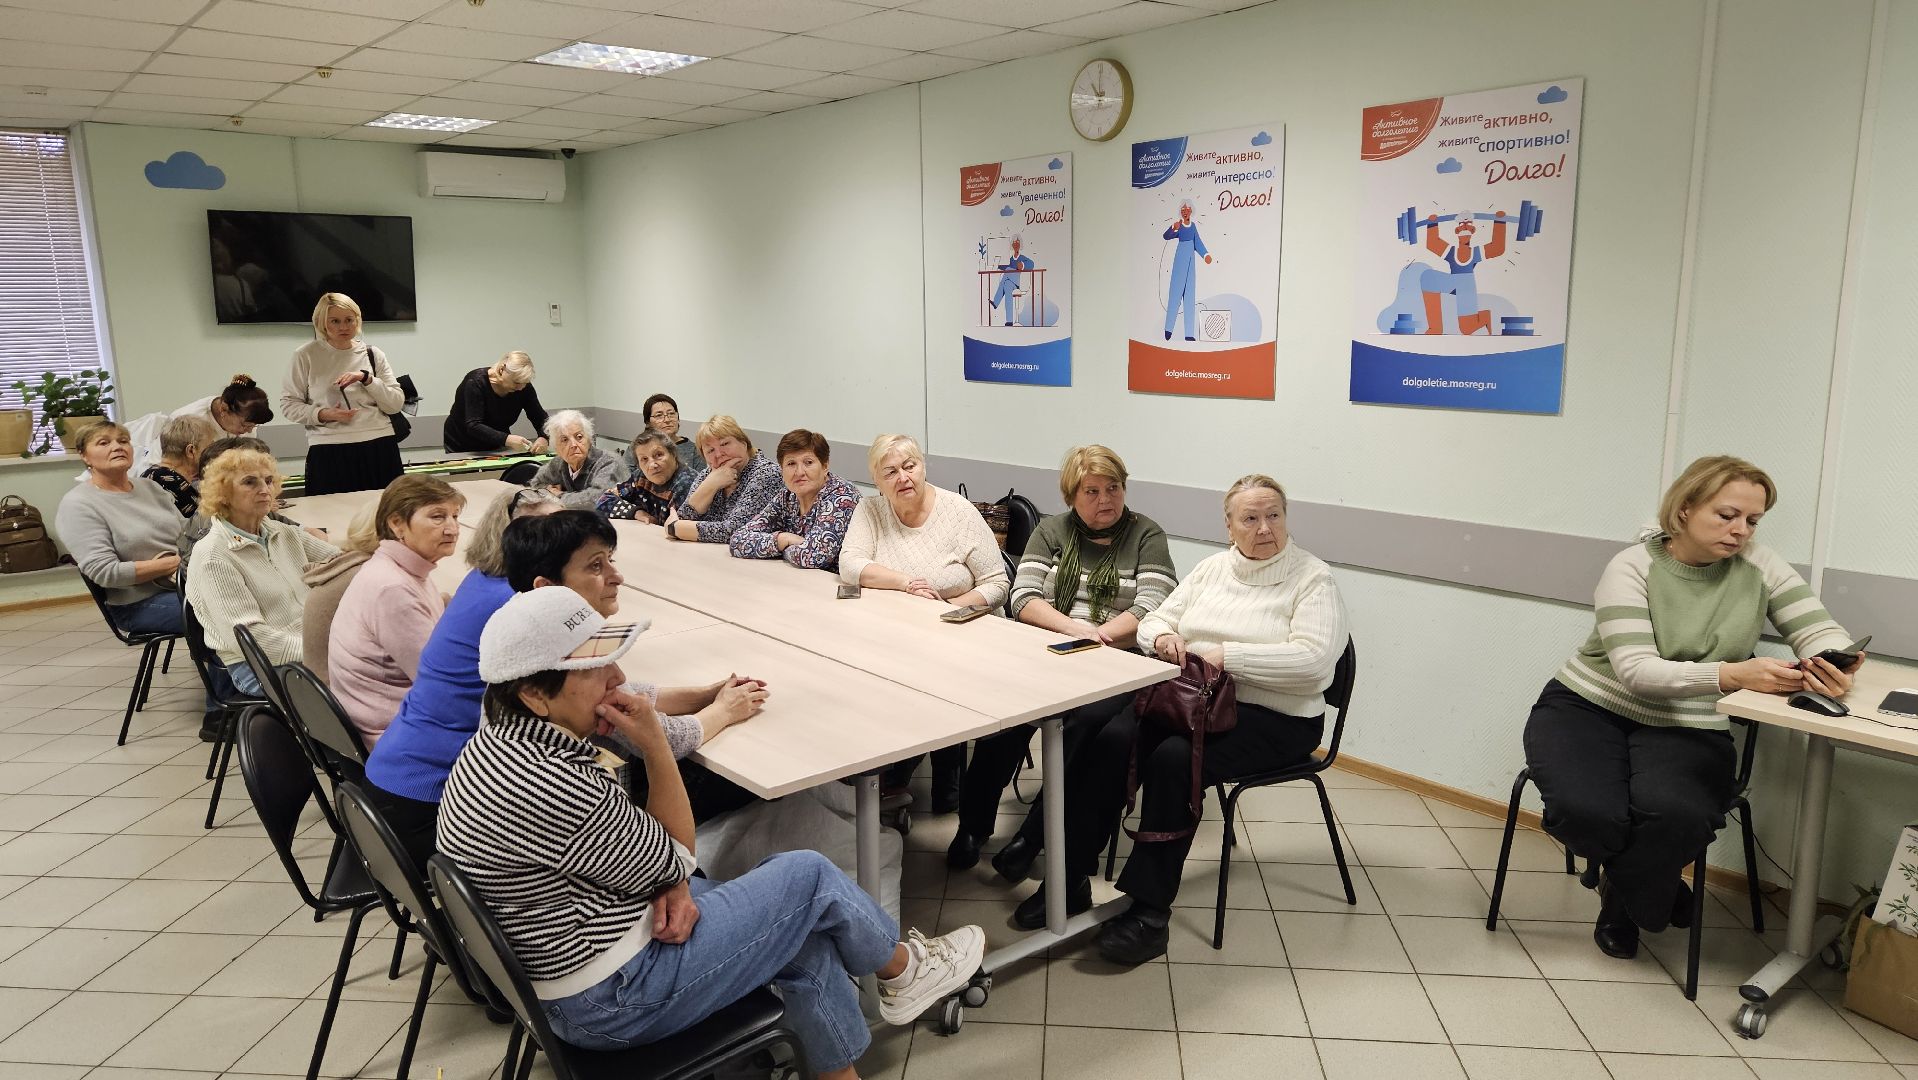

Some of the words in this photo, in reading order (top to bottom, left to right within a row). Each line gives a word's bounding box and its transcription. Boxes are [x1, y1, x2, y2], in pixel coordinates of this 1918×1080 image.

[1440, 114, 1484, 127] Живите
[1483, 111, 1553, 129] активно,
[1438, 136, 1480, 148] живите
[1478, 129, 1570, 154] спортивно!
[1186, 151, 1217, 162] Живите
[1215, 151, 1264, 165] активно,
[1214, 165, 1276, 185] интересно!
[1484, 153, 1567, 185] Долго!
[1022, 175, 1057, 187] активно,
[1020, 187, 1066, 205] увлеченно!
[1217, 186, 1273, 211] Долго!
[1024, 204, 1065, 226] Долго!
[1165, 368, 1231, 381] dolgoletie.mosreg.ru
[1402, 376, 1497, 391] dolgoletie.mosreg.ru
